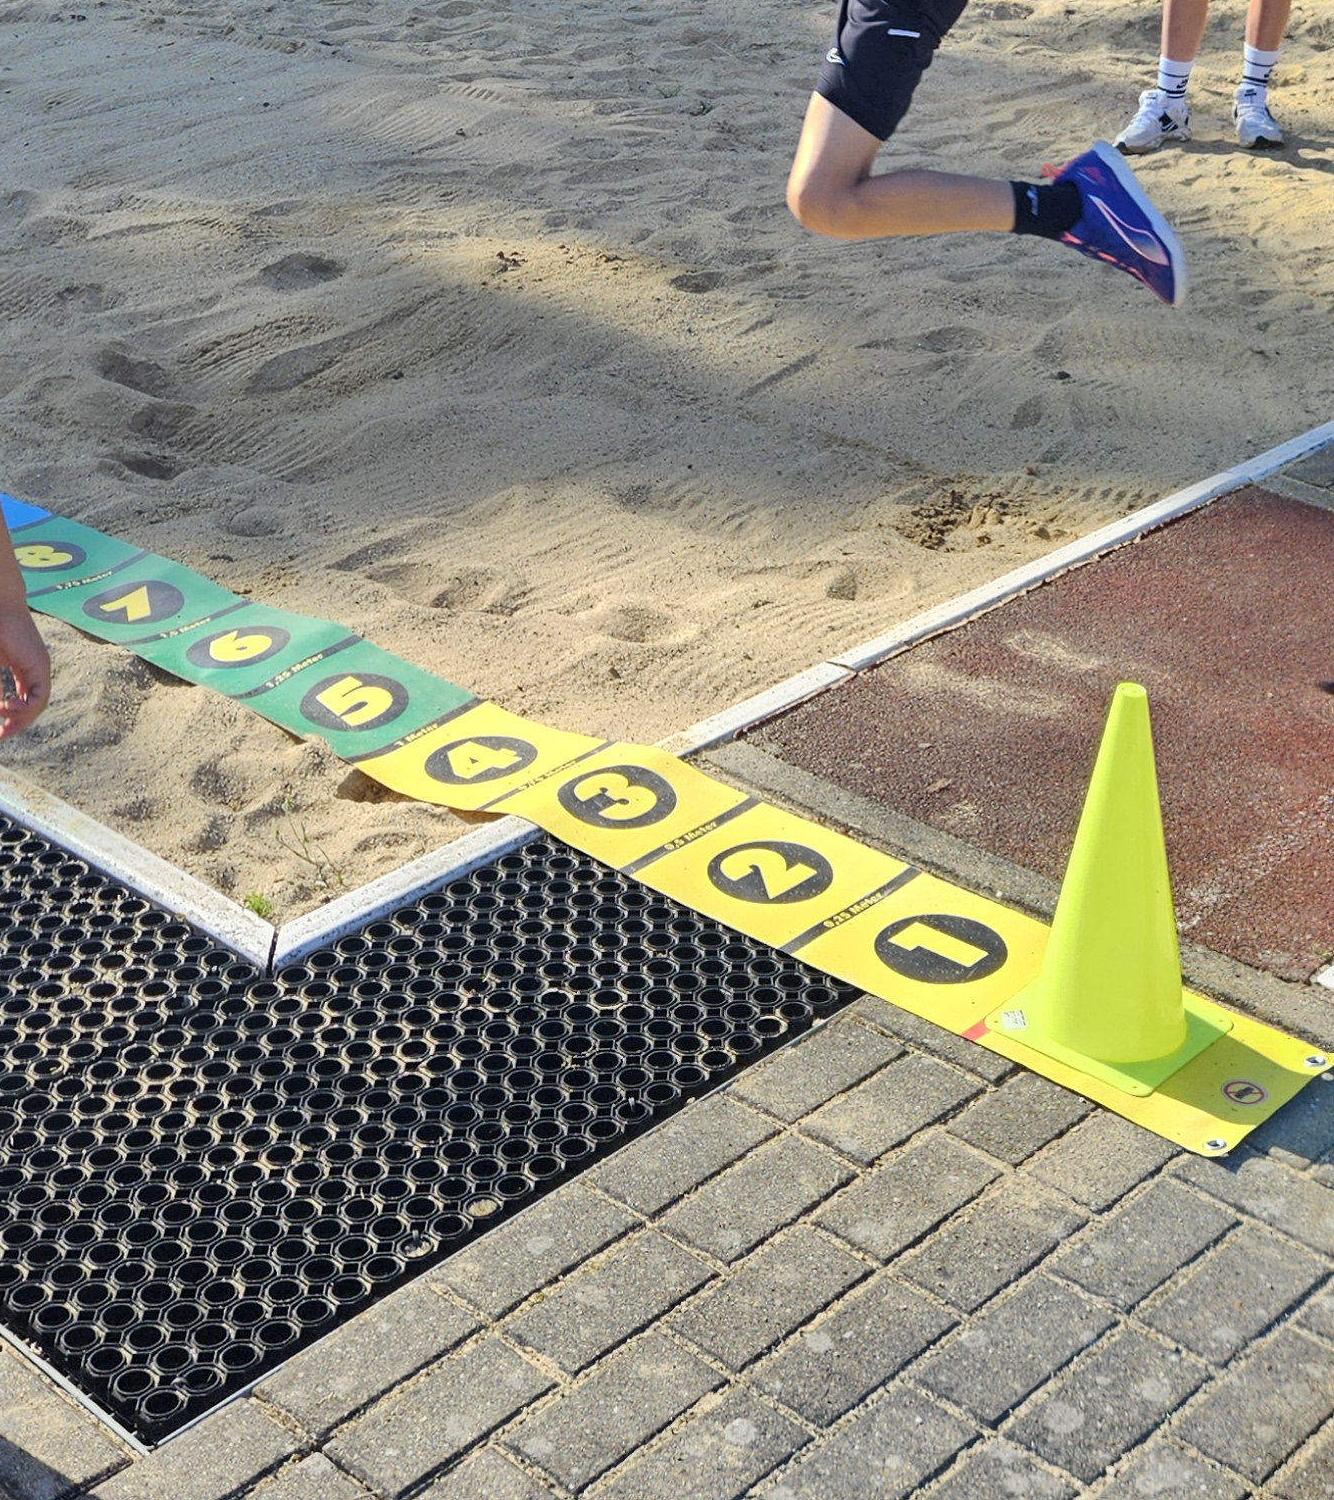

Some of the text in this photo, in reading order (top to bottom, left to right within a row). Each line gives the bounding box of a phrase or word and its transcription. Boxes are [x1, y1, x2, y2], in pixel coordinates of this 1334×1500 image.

[99, 585, 153, 622] 7
[208, 630, 273, 662] 6
[315, 675, 394, 726] 5
[446, 740, 524, 779] 4
[573, 772, 658, 821] 3
[719, 846, 817, 899] 2
[887, 921, 990, 968] 1
